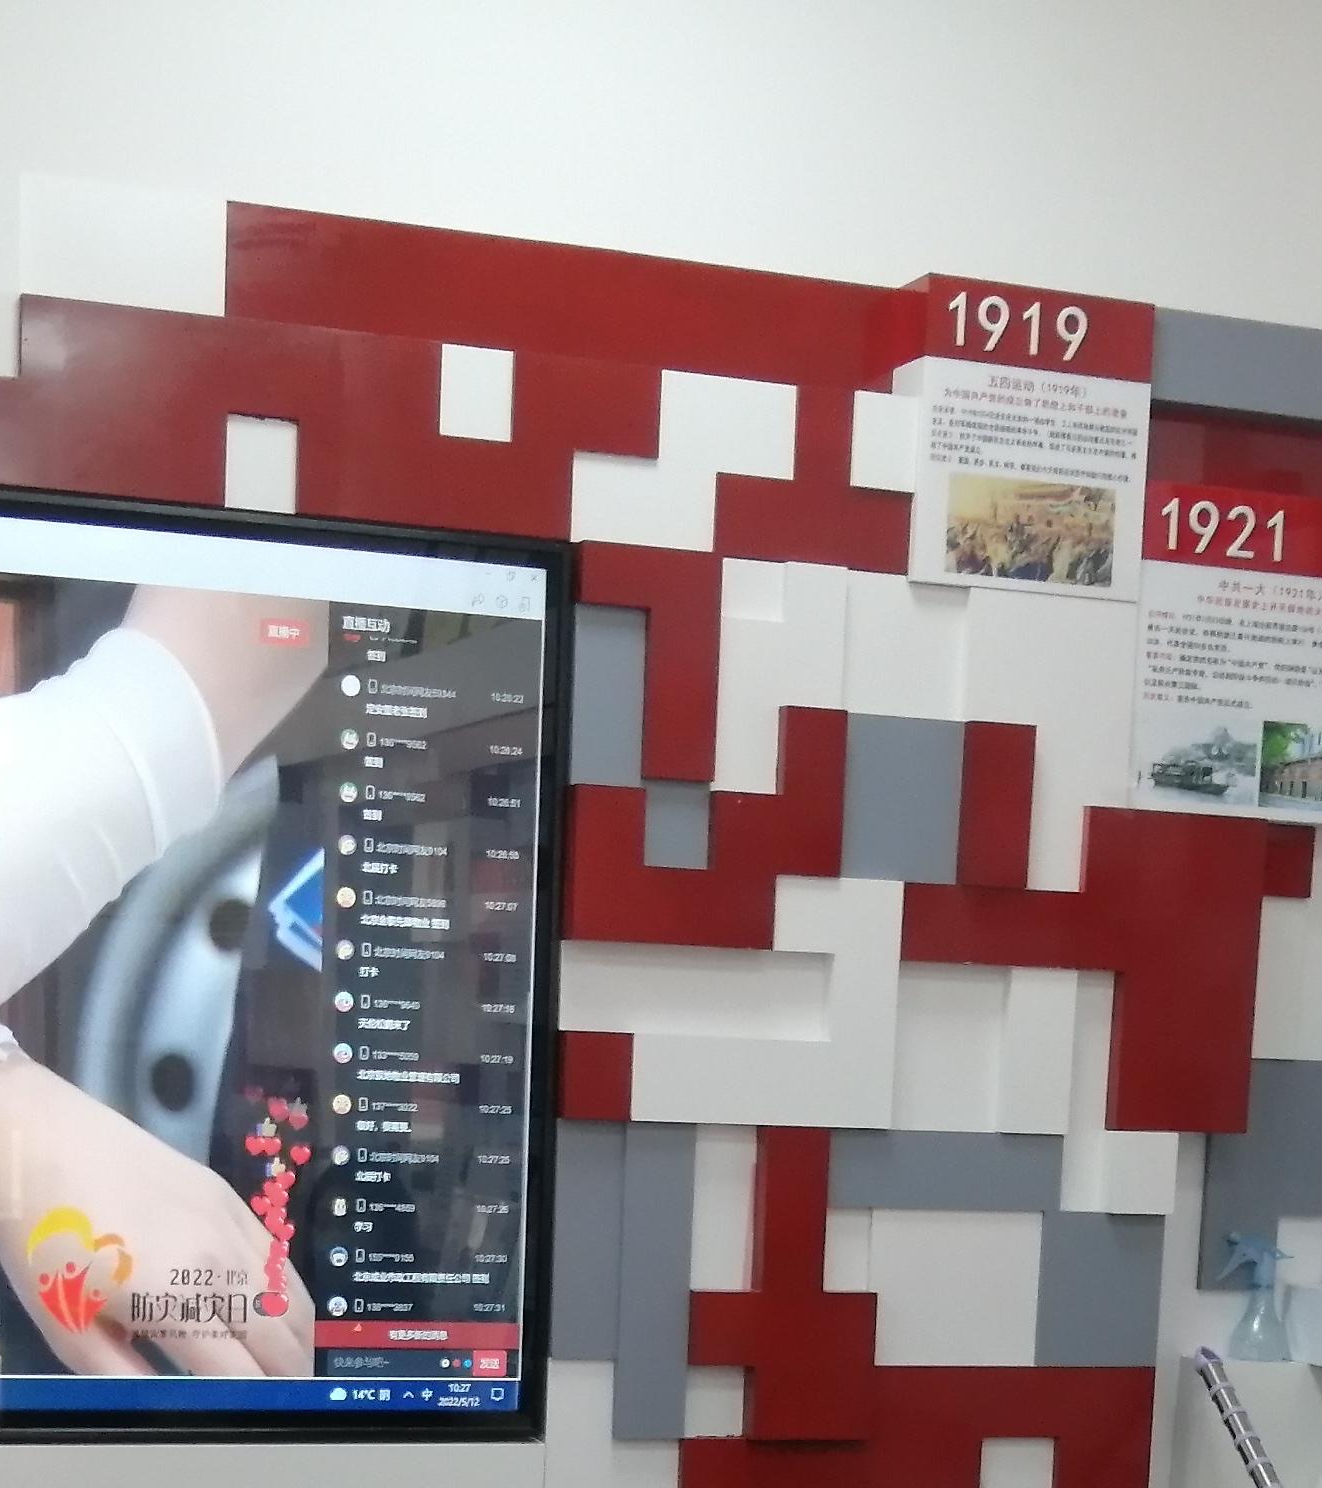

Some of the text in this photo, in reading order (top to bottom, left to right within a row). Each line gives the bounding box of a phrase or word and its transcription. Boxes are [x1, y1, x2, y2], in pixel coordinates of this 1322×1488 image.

[948, 291, 1088, 362] 1919
[1161, 497, 1285, 562] 1921
[131, 1292, 248, 1323] 防灾减灾日
